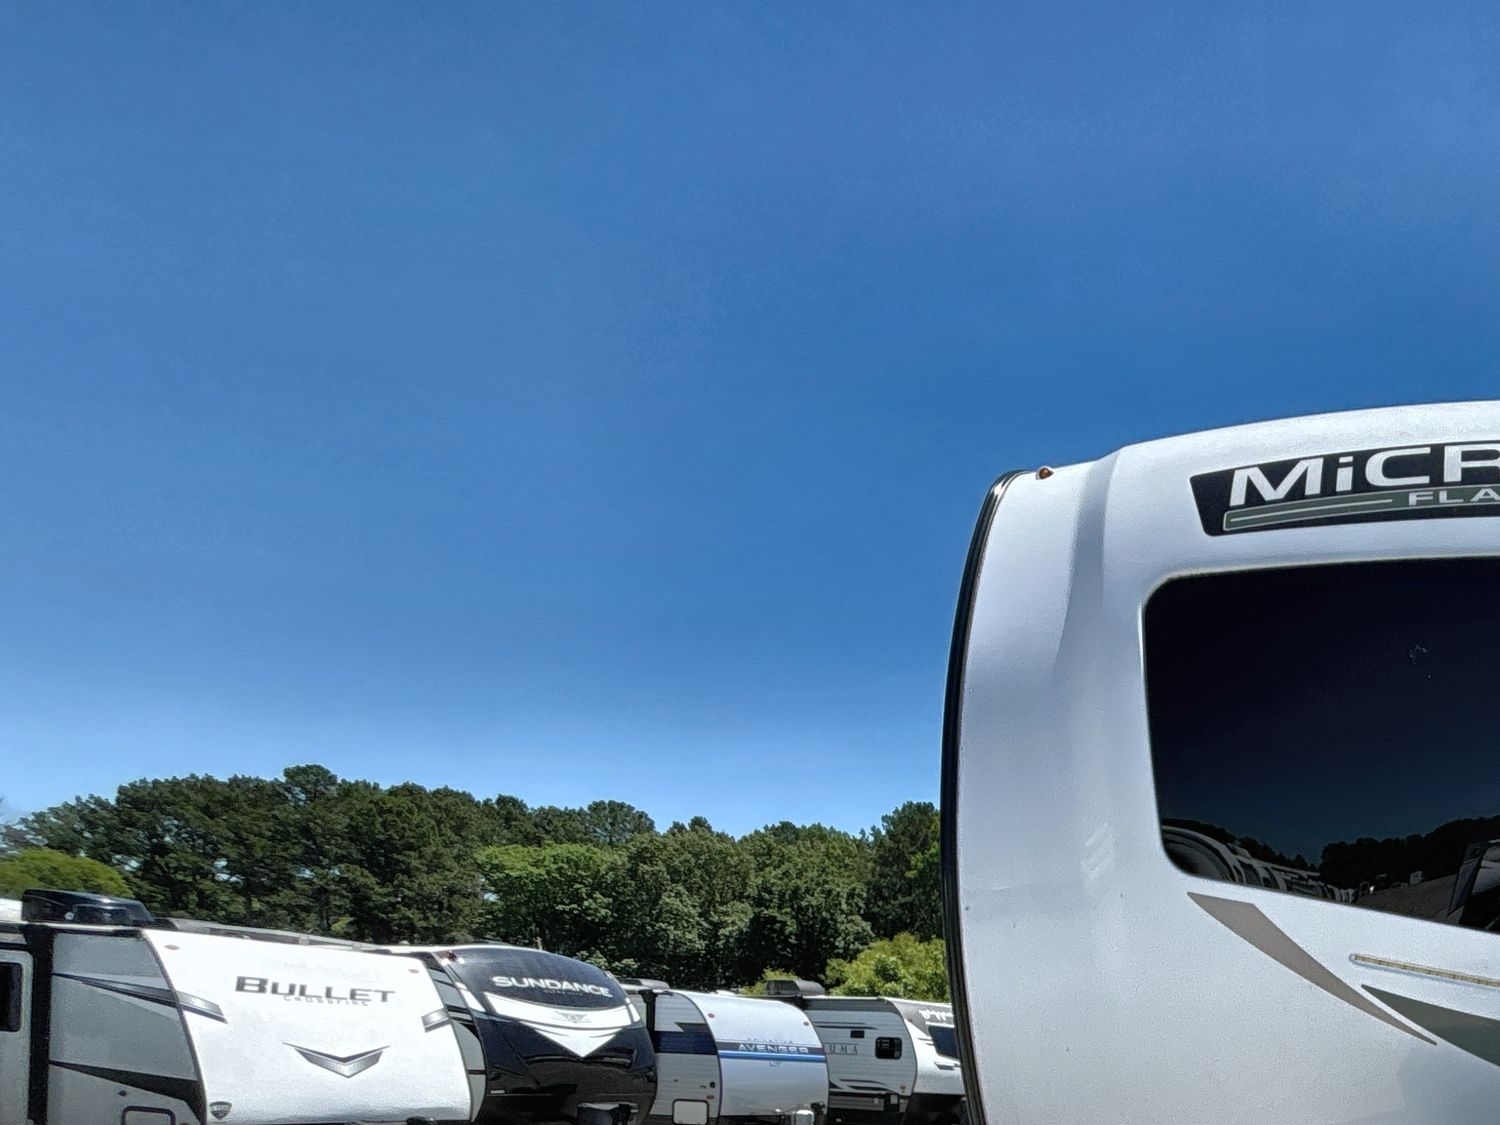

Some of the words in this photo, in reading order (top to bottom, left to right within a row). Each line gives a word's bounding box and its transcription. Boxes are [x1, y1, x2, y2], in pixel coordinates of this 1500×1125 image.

[235, 976, 396, 1003] BULLET
[492, 976, 614, 998] SUNDANCE
[738, 1043, 809, 1055] AVENGER
